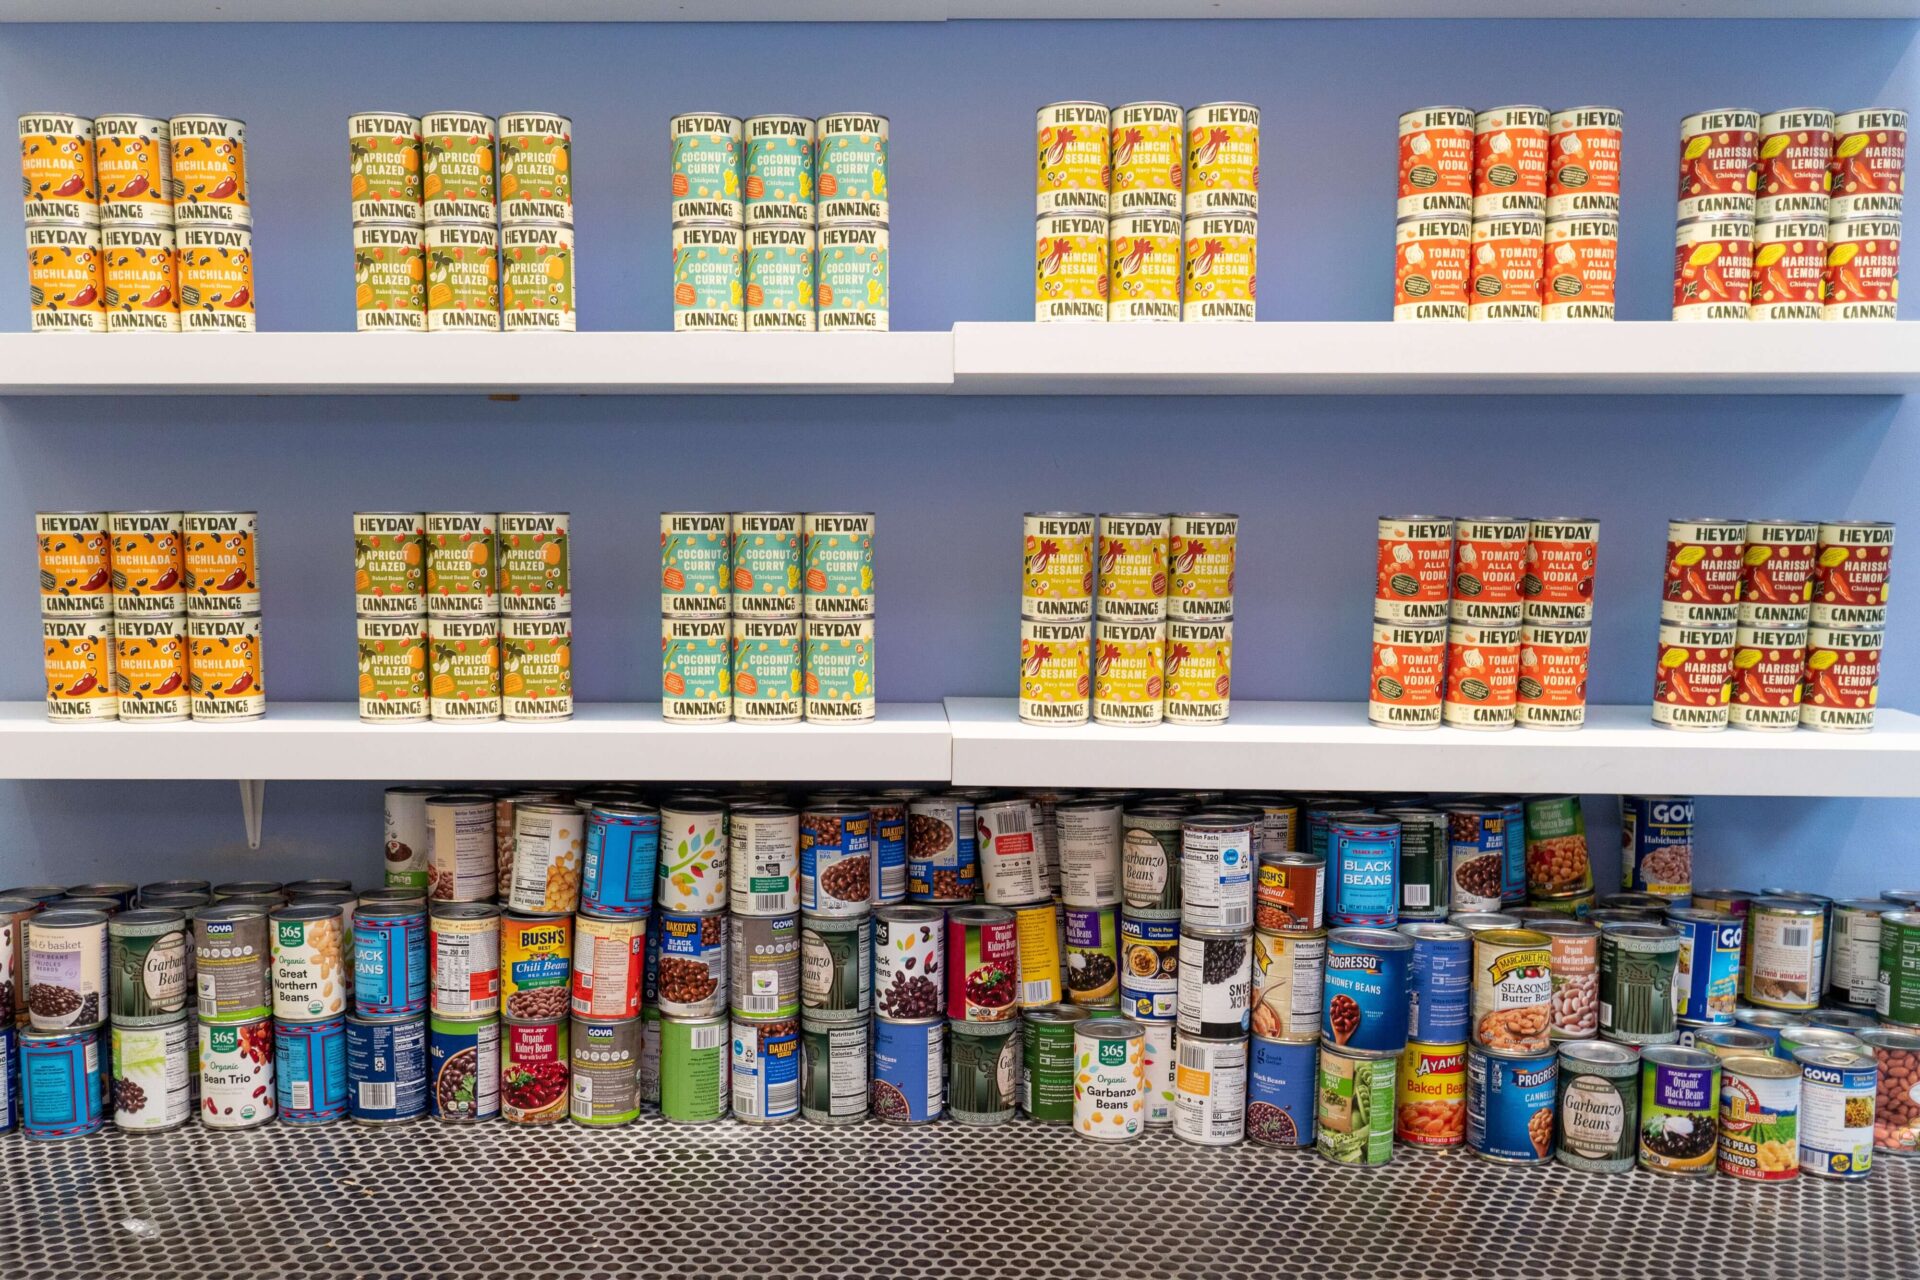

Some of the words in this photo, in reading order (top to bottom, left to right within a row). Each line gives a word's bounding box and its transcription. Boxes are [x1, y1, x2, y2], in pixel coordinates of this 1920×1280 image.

[1124, 108, 1177, 123] HEYDAY
[356, 119, 412, 135] HEYDAY
[677, 119, 731, 134] HEYDAY
[1702, 114, 1758, 130] HEYDAY
[1134, 142, 1169, 152] KIMCHI
[1708, 147, 1752, 158] HARISSA
[364, 153, 406, 163] APRICOT
[682, 152, 726, 162] COCONUT
[1132, 154, 1170, 164] SESAME
[688, 163, 720, 174] CURRY
[1713, 159, 1748, 169] LEMON
[366, 165, 404, 175] GLAZED
[1123, 192, 1172, 206] CANNING
[1698, 197, 1751, 212] CANNING
[360, 203, 411, 218] CANNING
[679, 203, 728, 217] CANNING
[1490, 223, 1543, 236] HEYDAY
[106, 231, 161, 245] HEYDAY
[1500, 248, 1537, 258] TOMATO
[109, 270, 162, 281] ENCHILADA
[1503, 270, 1535, 280] VODKA
[1488, 305, 1537, 318] CANNING
[112, 314, 161, 327] CANNING
[42, 517, 99, 531] HEYDAY
[673, 517, 725, 531] HEYDAY
[1535, 525, 1592, 539] HEYDAY
[45, 555, 100, 564] ENCHILADA
[677, 550, 721, 560] COCONUT
[1542, 550, 1582, 561] TOMATO
[684, 562, 715, 571] CURRY
[1543, 572, 1577, 581] VODKA
[47, 597, 99, 610] CANNING
[673, 597, 723, 610] CANNING
[1529, 604, 1581, 618] CANNING
[513, 622, 566, 635] HEYDAY
[1033, 625, 1086, 639] HEYDAY
[1828, 633, 1882, 647] HEYDAY
[521, 655, 561, 664] APRICOT
[1043, 658, 1077, 667] KIMCHI
[524, 666, 559, 674] GLAZED
[1041, 669, 1078, 678] SESAME
[1834, 664, 1875, 674] HARISSA
[1838, 676, 1871, 686] LEMON
[515, 700, 564, 714] CANNING
[1031, 703, 1080, 717] CANNING
[1821, 709, 1870, 724] CANNING
[1653, 803, 1694, 824] GOY
[1344, 860, 1391, 871] BLACK
[1127, 865, 1154, 881] Beans
[1344, 874, 1392, 885] BEANS
[208, 924, 232, 933] GOYA
[666, 921, 697, 933] DAKOTA'S
[773, 920, 794, 929] GOYA
[280, 926, 301, 938] 365
[995, 931, 1012, 940] Organic
[1080, 929, 1092, 939] Beans
[522, 930, 564, 947] BUSH'S
[48, 941, 81, 949] basket
[667, 944, 693, 952] BEANS
[988, 940, 1005, 952] Kidney
[355, 950, 383, 961] LACK
[1564, 946, 1583, 956] Organic
[147, 956, 186, 973] Garban
[279, 956, 306, 967] Organic
[1328, 954, 1376, 968] PROGRESSO
[1500, 954, 1534, 967] MARGARET
[355, 964, 384, 974] EANS
[516, 963, 540, 973] Chili
[543, 962, 568, 970] Beans
[279, 969, 307, 979] Great
[1754, 969, 1778, 978] QUALITY
[274, 980, 317, 990] Northern
[1331, 977, 1353, 989] KIDNEY
[1356, 982, 1381, 994] BEANS
[280, 991, 309, 1002] Beans
[1502, 994, 1532, 1003] Butter
[588, 1028, 613, 1037] GOYA
[212, 1032, 235, 1045] 365
[522, 1033, 544, 1044] Organic
[515, 1043, 534, 1054] Kidney
[535, 1043, 552, 1052] Beans
[1101, 1045, 1124, 1057] 365
[210, 1062, 239, 1072] Organic
[1417, 1056, 1456, 1076] AYAM
[204, 1074, 226, 1085] Bean
[229, 1074, 251, 1084] Trio
[1097, 1075, 1126, 1085] Organic
[1267, 1076, 1286, 1085] Beans
[1804, 1067, 1841, 1084] GOYA
[1407, 1079, 1442, 1094] Baked
[1673, 1077, 1698, 1089] Organic
[1087, 1086, 1136, 1098] Garbanzo
[1664, 1085, 1683, 1098] Black
[1685, 1088, 1704, 1100] Beans
[1096, 1099, 1128, 1110] Beans
[1565, 1094, 1621, 1116] Garbanzo
[1732, 1096, 1777, 1124] Harvest
[1573, 1112, 1611, 1130] Beans
[1733, 1142, 1756, 1153] PEAS
